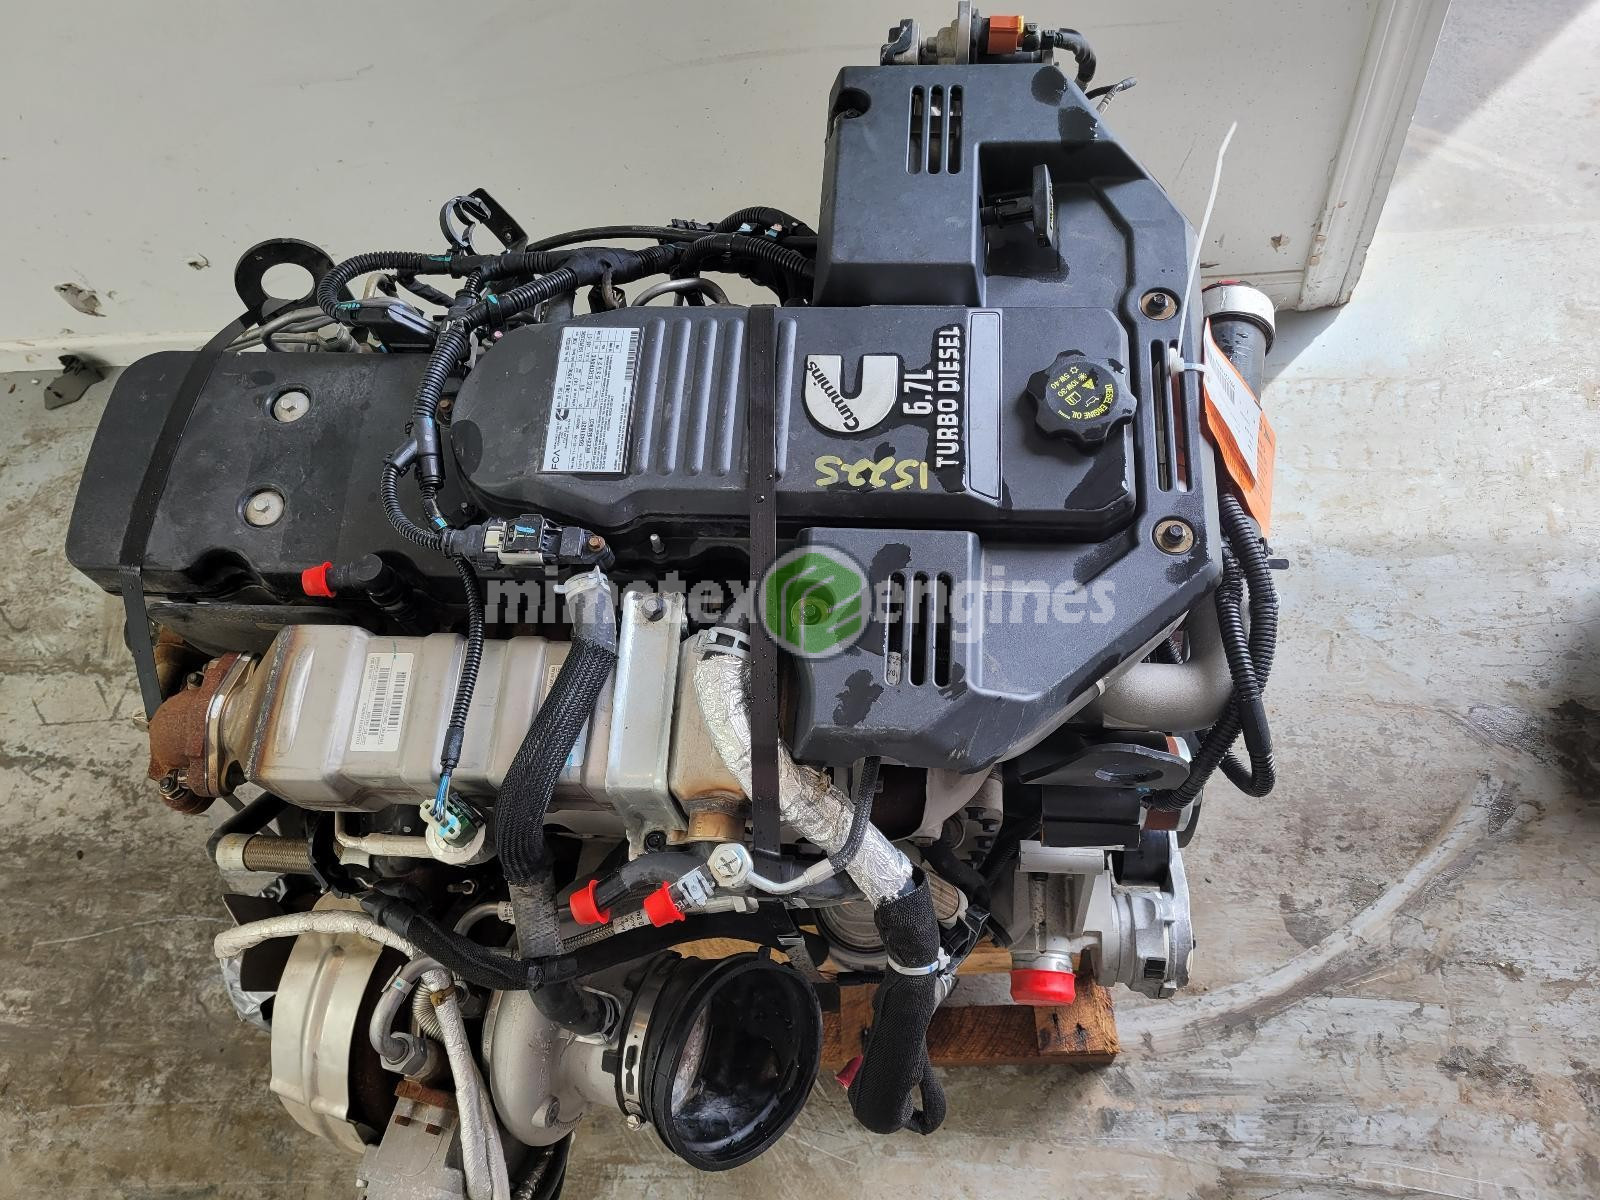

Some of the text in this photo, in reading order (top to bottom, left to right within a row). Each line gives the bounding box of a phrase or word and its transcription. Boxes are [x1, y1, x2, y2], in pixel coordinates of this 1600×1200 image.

[806, 361, 860, 431] Cummins
[902, 369, 934, 415] 6.7L
[936, 326, 961, 468] TURBO DIESEL
[1103, 383, 1114, 404] DIESEL
[1071, 410, 1082, 419] OIL
[1083, 404, 1108, 420] ENGINE
[551, 450, 561, 469] FCA
